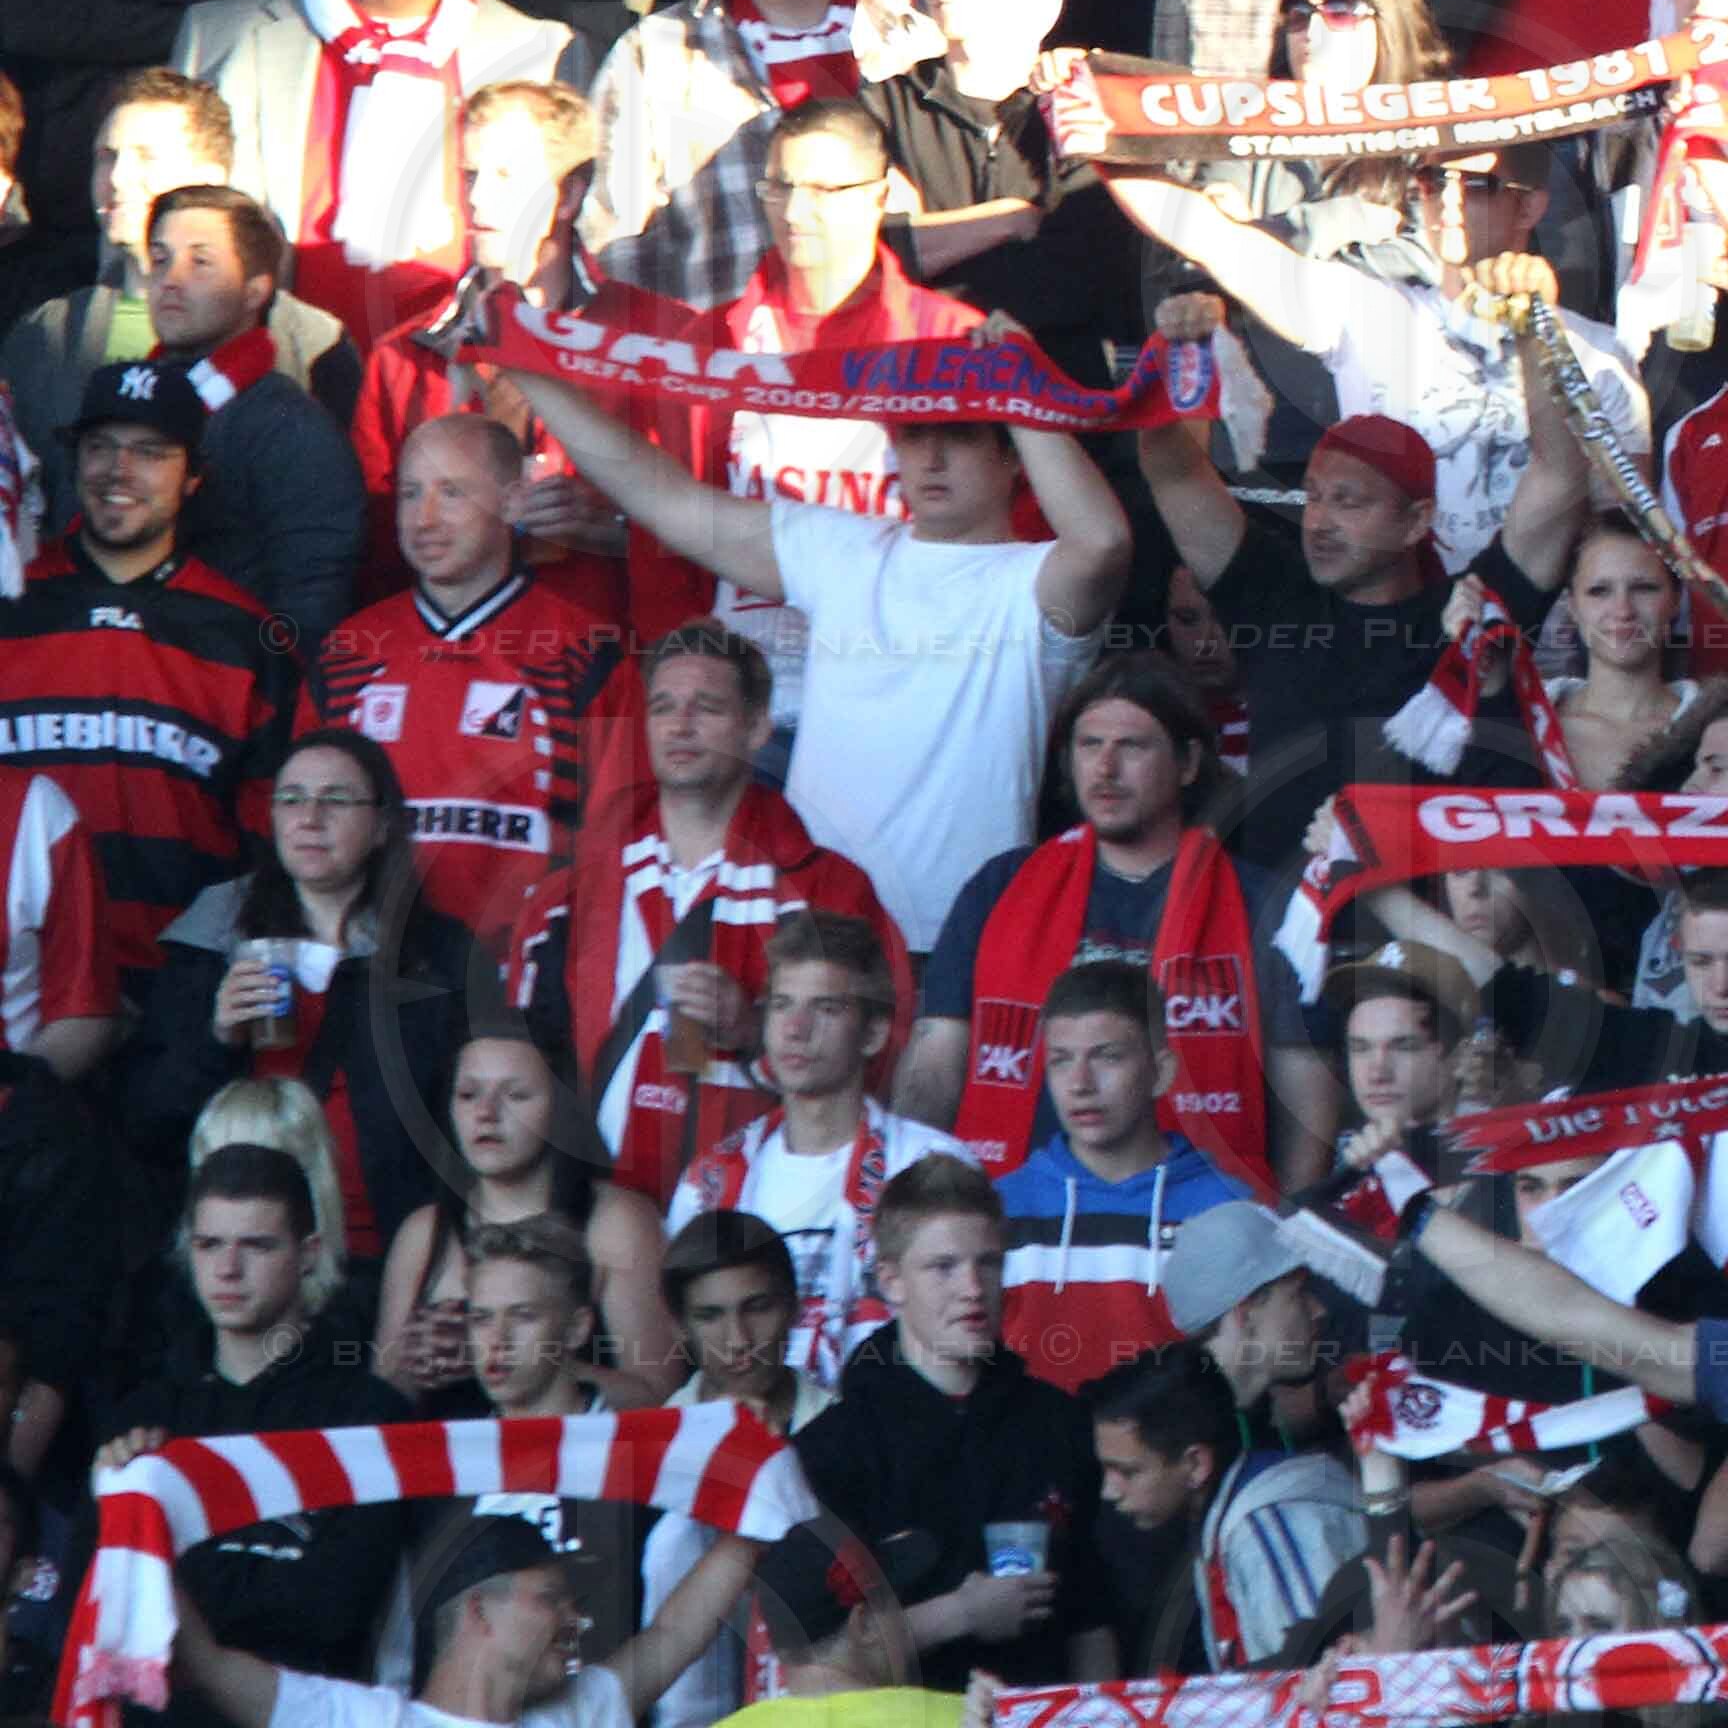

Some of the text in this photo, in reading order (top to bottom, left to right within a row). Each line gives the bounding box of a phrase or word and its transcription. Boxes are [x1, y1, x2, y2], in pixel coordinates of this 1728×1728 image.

[1140, 77, 1495, 128] CUPSIEGER
[1518, 40, 1672, 101] 1981
[89, 606, 144, 631] FILA
[1173, 1091, 1243, 1114] 1902
